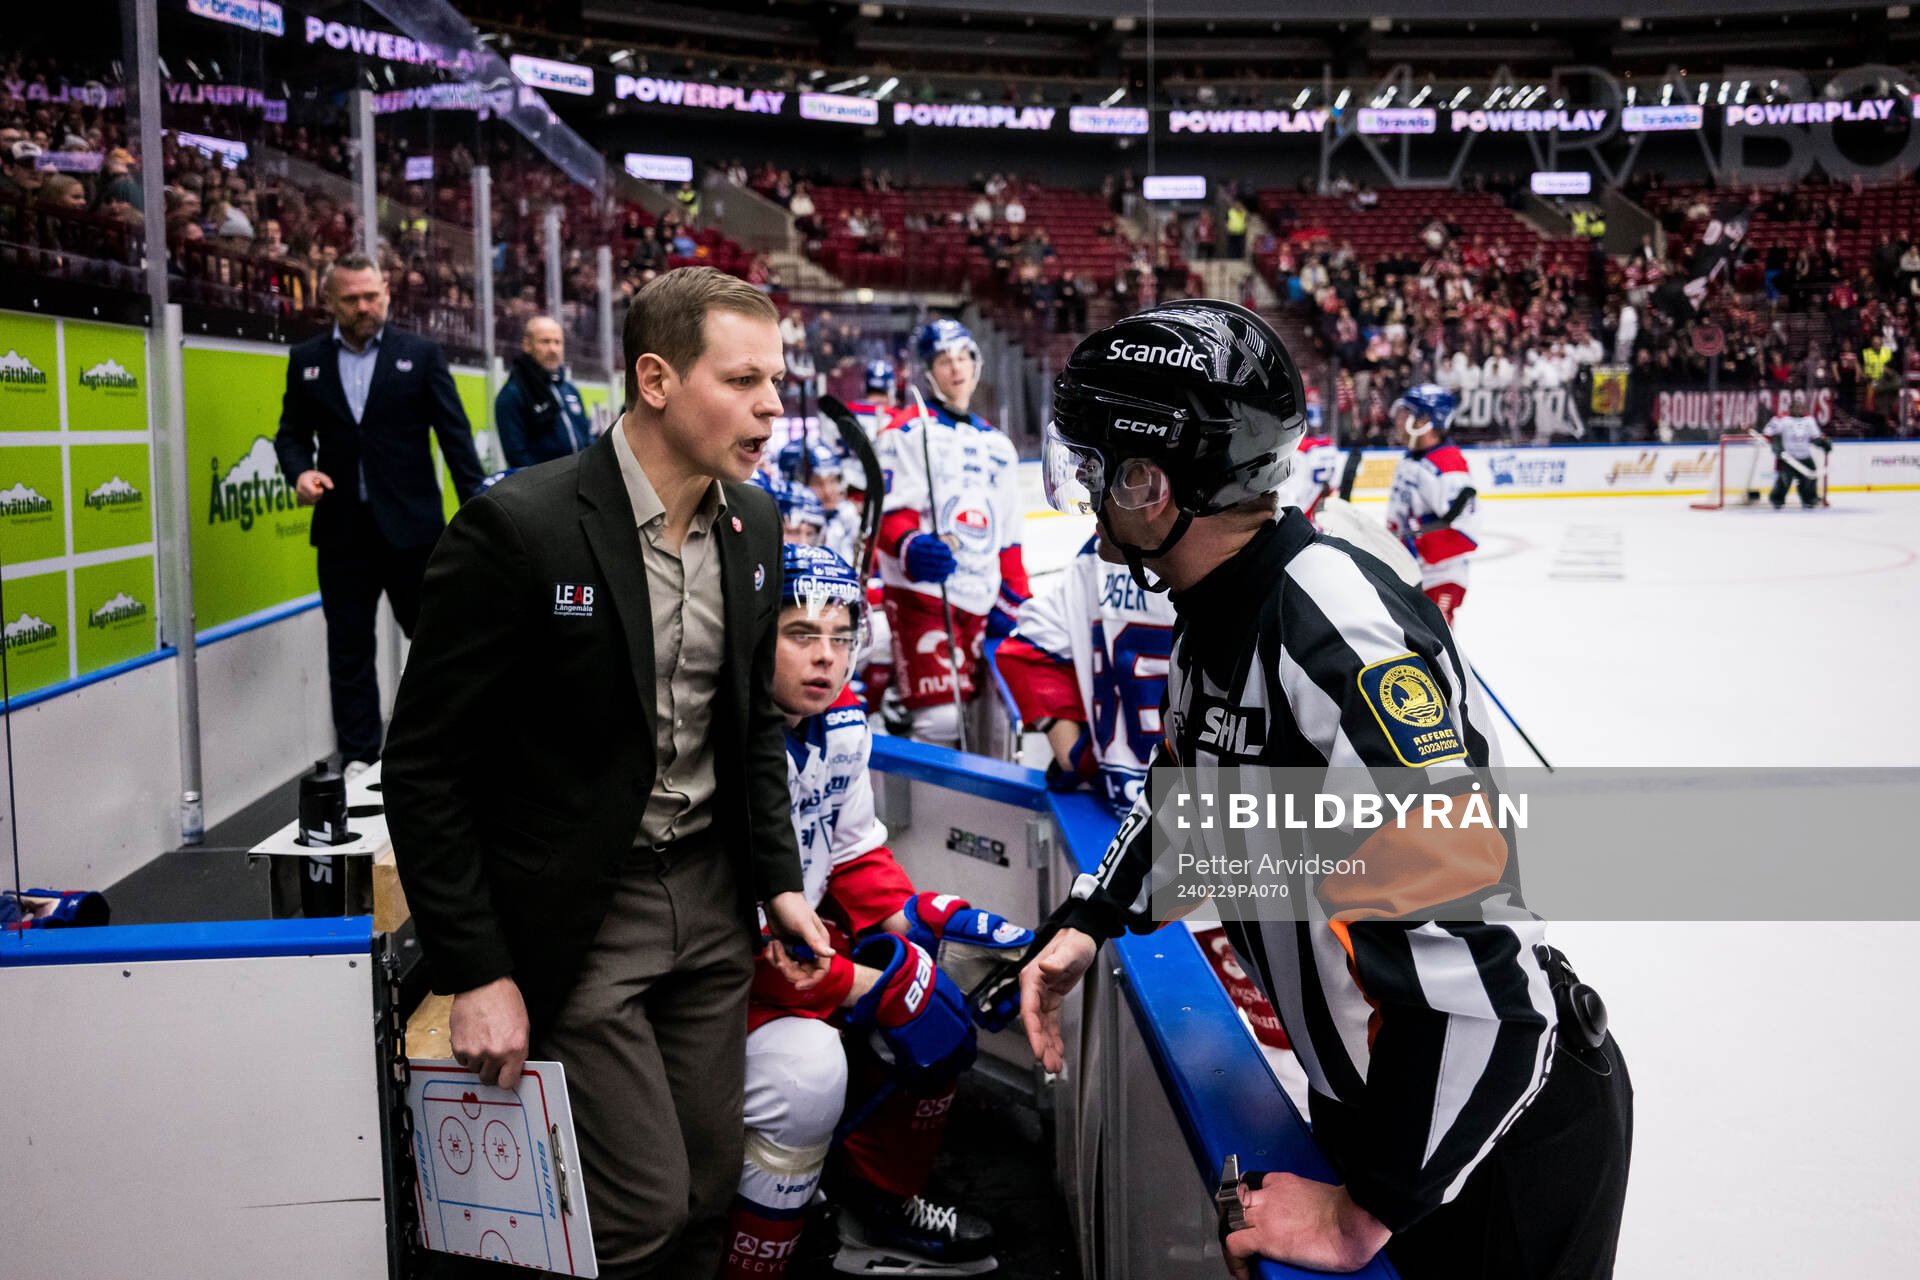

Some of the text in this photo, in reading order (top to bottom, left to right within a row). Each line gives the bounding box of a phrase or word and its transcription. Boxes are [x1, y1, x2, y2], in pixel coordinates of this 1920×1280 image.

[615, 74, 786, 114] POWERPLAY
[893, 101, 1055, 130] POWERPLAY
[1168, 110, 1330, 133] POWERPLAY
[1451, 109, 1607, 131] POWERPLAY
[1726, 98, 1896, 127] POWERPLAY
[1107, 339, 1208, 371] Scandic
[1114, 418, 1168, 437] CCM
[556, 584, 594, 605] LEAB
[1198, 706, 1264, 756] SHL
[1412, 729, 1455, 746] REFEREE
[1418, 739, 1459, 756] 2023/2024
[415, 1129, 433, 1202] BAUER
[536, 1140, 557, 1220] BAUER
